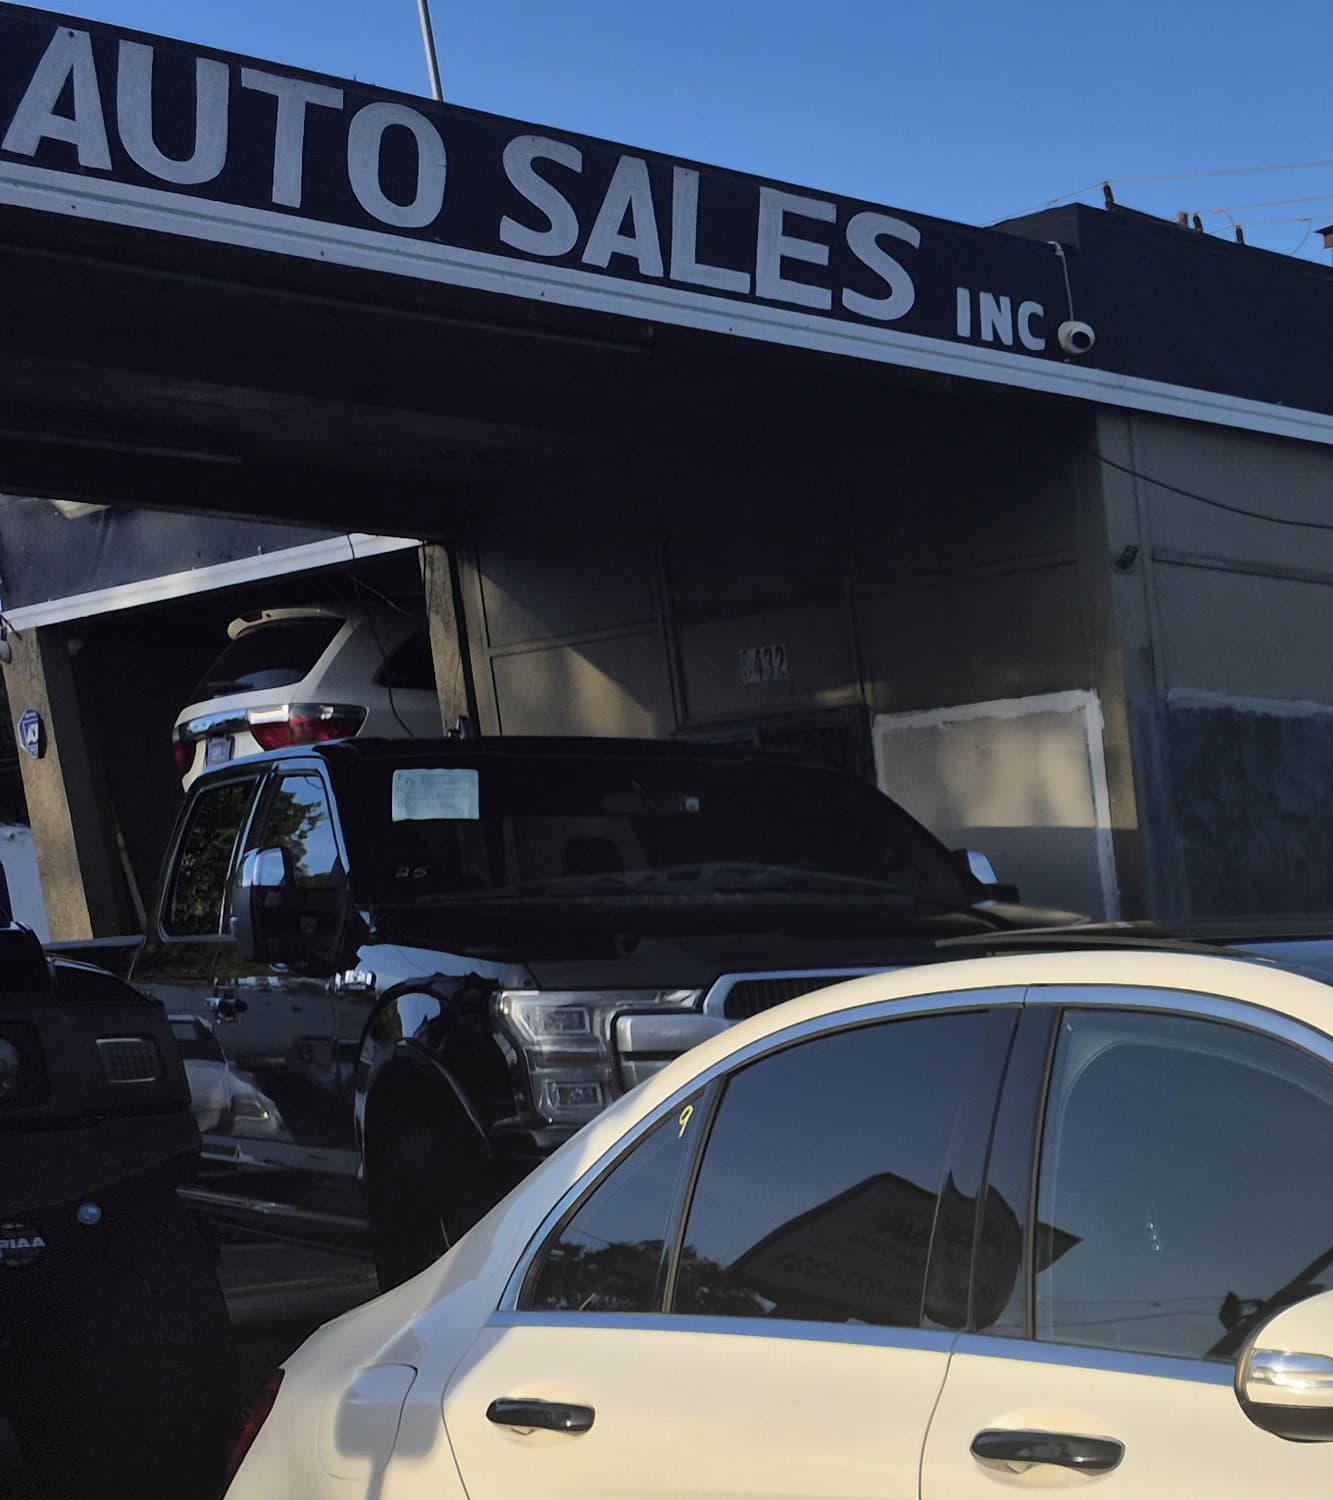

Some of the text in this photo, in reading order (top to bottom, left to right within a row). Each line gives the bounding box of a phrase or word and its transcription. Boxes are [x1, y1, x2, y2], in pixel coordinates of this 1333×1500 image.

[2, 25, 1045, 352] AUTO SALES INC
[677, 1105, 694, 1139] 9
